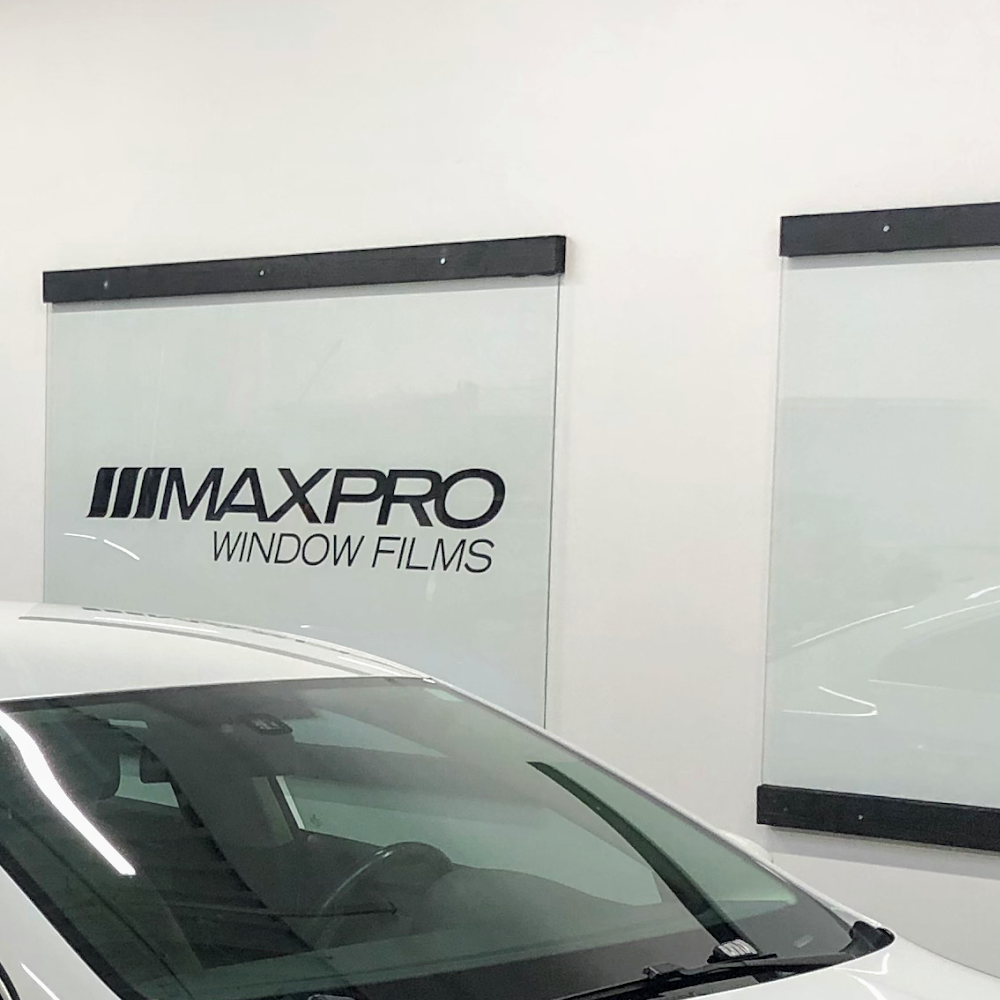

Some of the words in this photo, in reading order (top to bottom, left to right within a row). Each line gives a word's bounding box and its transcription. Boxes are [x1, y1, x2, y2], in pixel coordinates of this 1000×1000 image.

[158, 467, 506, 530] MAXPRO
[213, 530, 366, 567] WINDOW
[371, 536, 495, 574] FILMS
